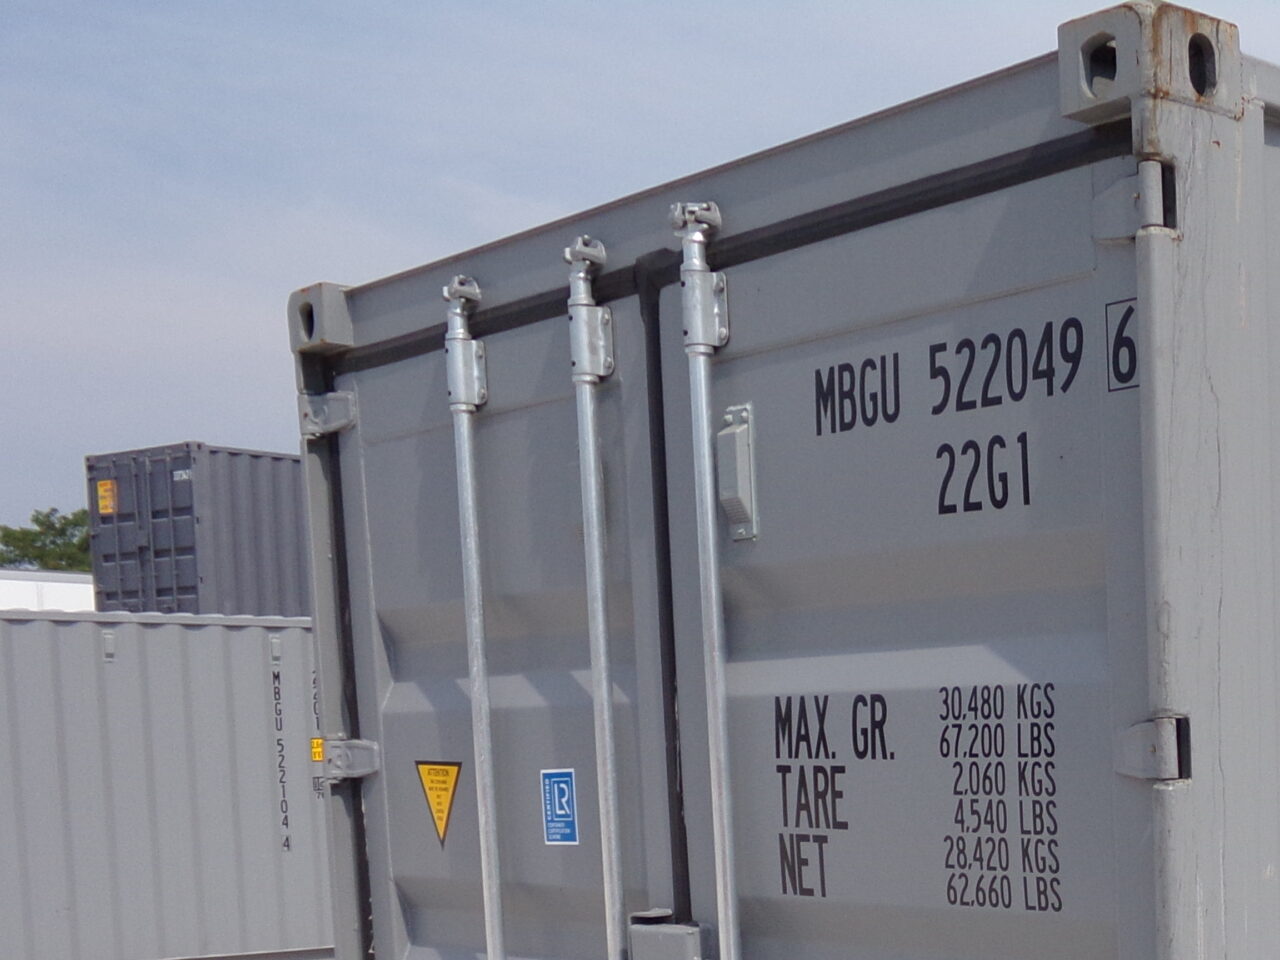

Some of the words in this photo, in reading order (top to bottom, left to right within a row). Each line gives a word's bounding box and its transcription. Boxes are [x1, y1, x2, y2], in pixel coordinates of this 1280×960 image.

[814, 352, 901, 436] MBGU
[929, 317, 1084, 415] 522049
[1111, 305, 1137, 384] 6
[936, 431, 1031, 515] 22G1
[271, 671, 283, 731] MBGU
[938, 684, 1005, 721] 30,480
[1016, 683, 1055, 719] KGS
[774, 694, 836, 760] MAX.
[852, 694, 895, 760] GR.
[939, 723, 1005, 759] 67,200
[1017, 722, 1056, 759] LBS
[276, 738, 289, 829] 522104
[775, 764, 849, 830] TARE
[952, 761, 1006, 797] 2,060
[1017, 761, 1057, 797] KGS
[954, 798, 1008, 834] 4,540
[1019, 799, 1058, 836] LBS
[283, 835, 291, 851] 4
[778, 832, 829, 898] NET
[943, 835, 1009, 872] 28,420
[1020, 837, 1061, 874] KGS
[946, 872, 1012, 909] 62,660
[1023, 876, 1063, 912] LBS
